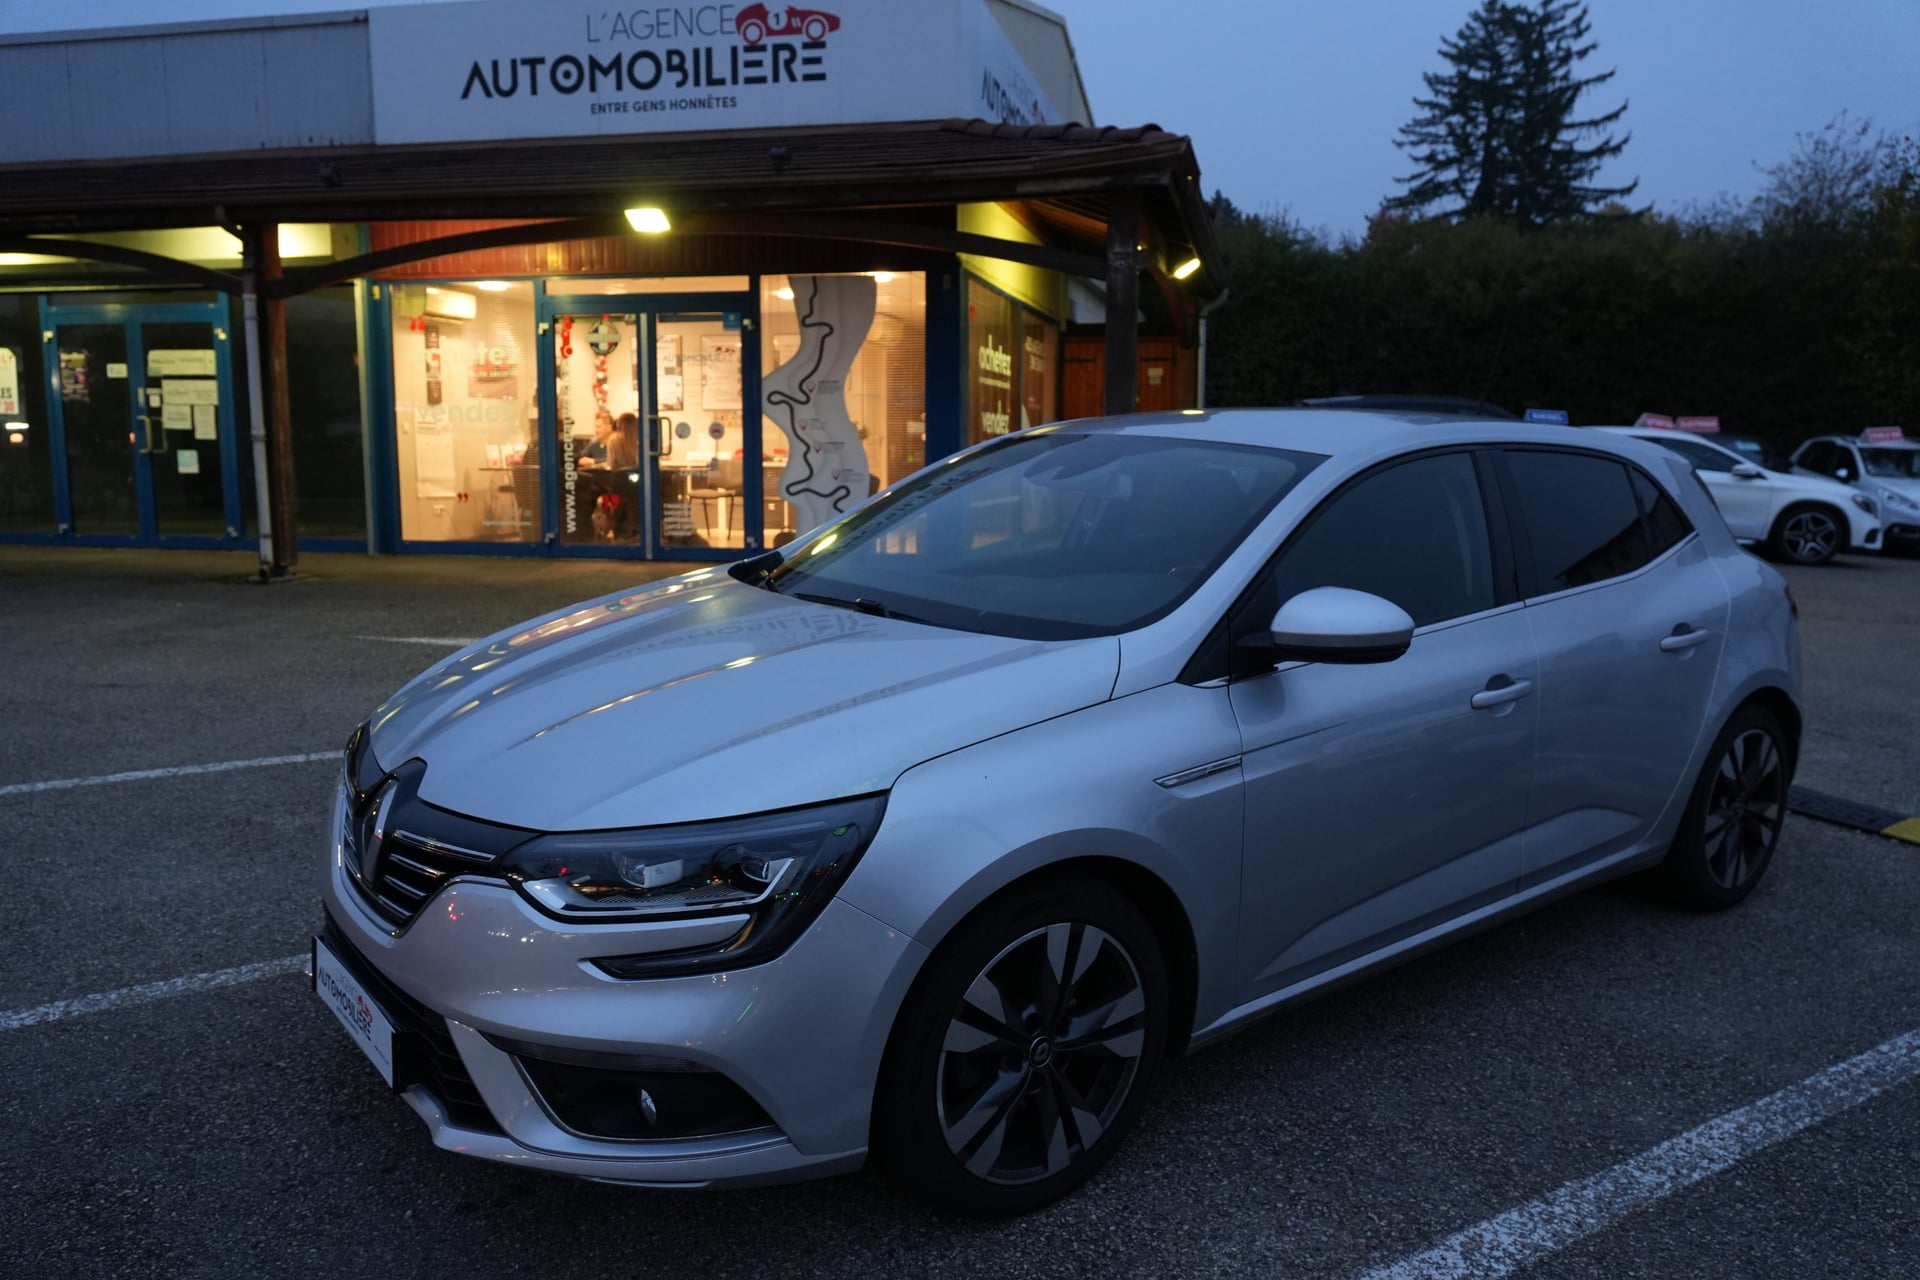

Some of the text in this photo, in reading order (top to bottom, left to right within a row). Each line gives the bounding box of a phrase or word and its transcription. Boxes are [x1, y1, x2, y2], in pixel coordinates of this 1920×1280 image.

[586, 4, 781, 43] L'AGENCE 1
[590, 96, 738, 115] ENTRE GENS HONNÊTES
[979, 334, 1012, 377] achetez
[417, 393, 517, 424] vendez
[981, 400, 1010, 435] vendez
